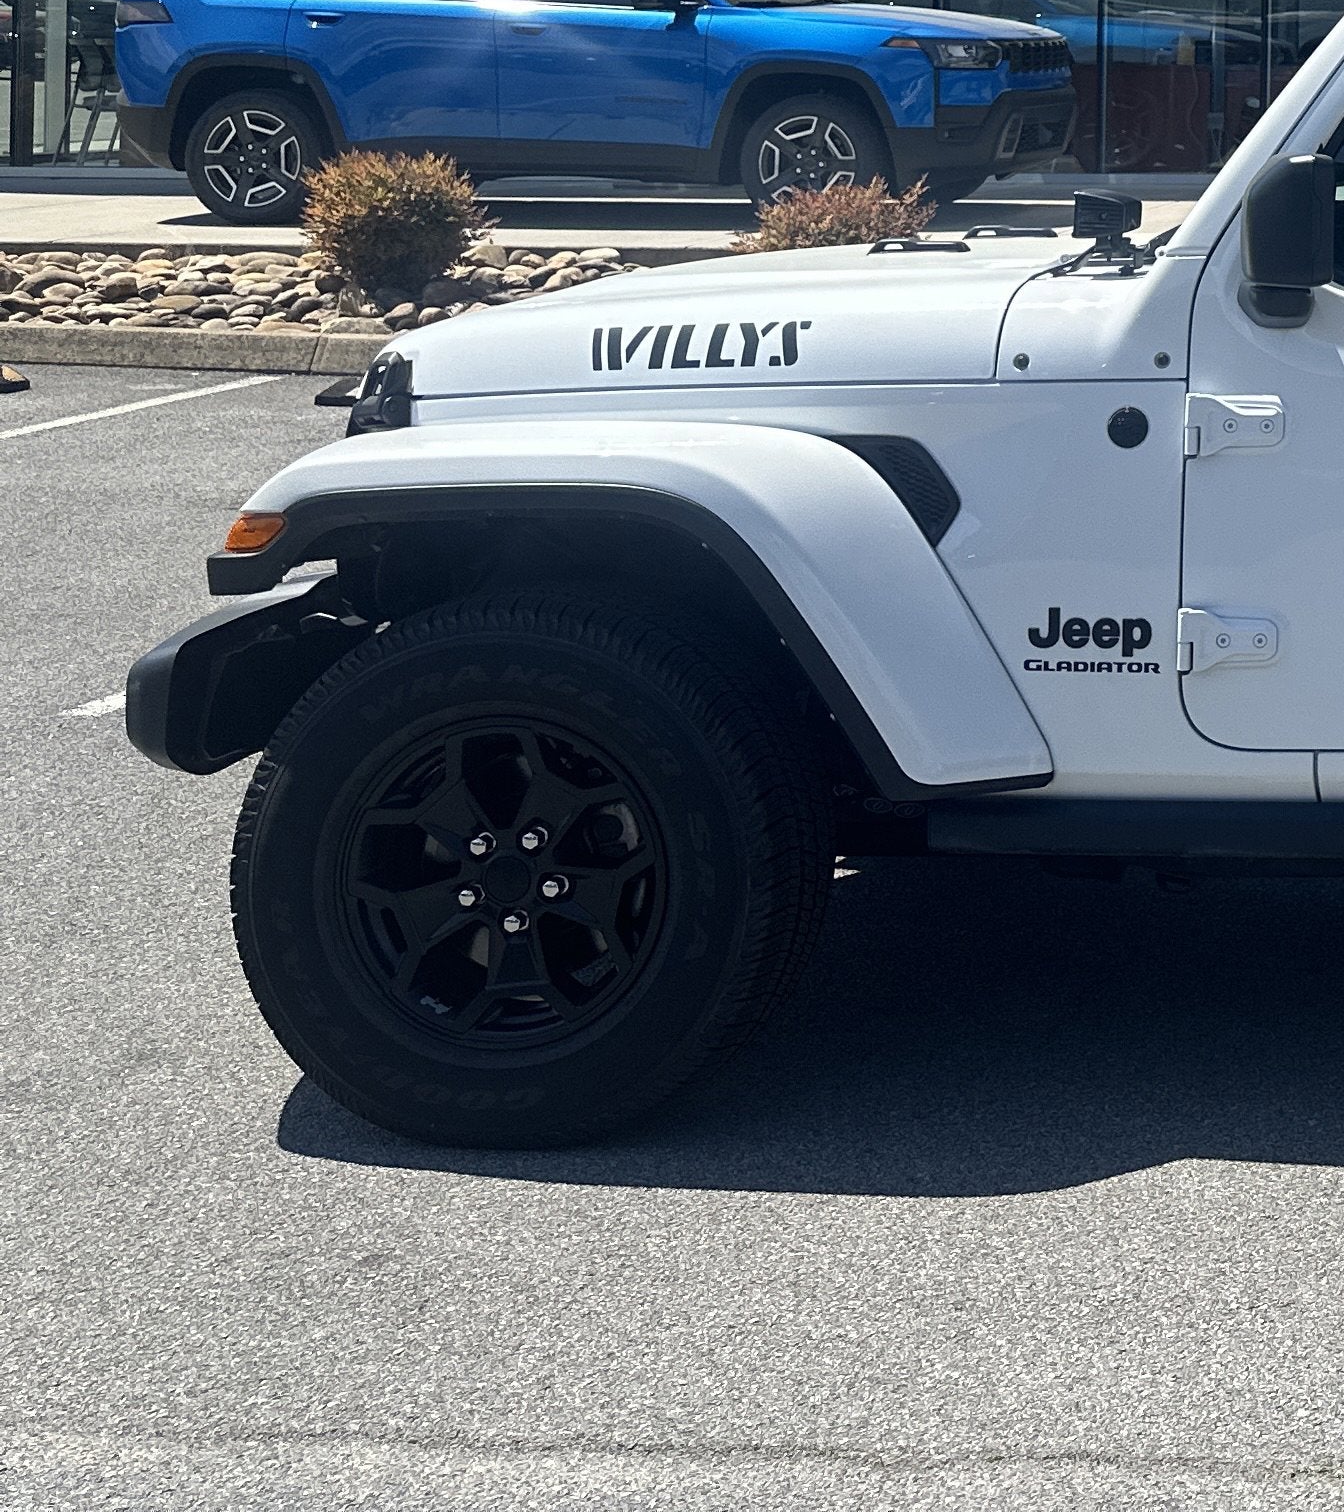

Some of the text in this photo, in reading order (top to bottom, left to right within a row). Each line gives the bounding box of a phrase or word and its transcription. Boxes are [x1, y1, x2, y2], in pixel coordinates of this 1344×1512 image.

[592, 321, 812, 371] WILLYS
[1028, 607, 1152, 657] Jeep
[1024, 659, 1161, 674] GLADIATOR
